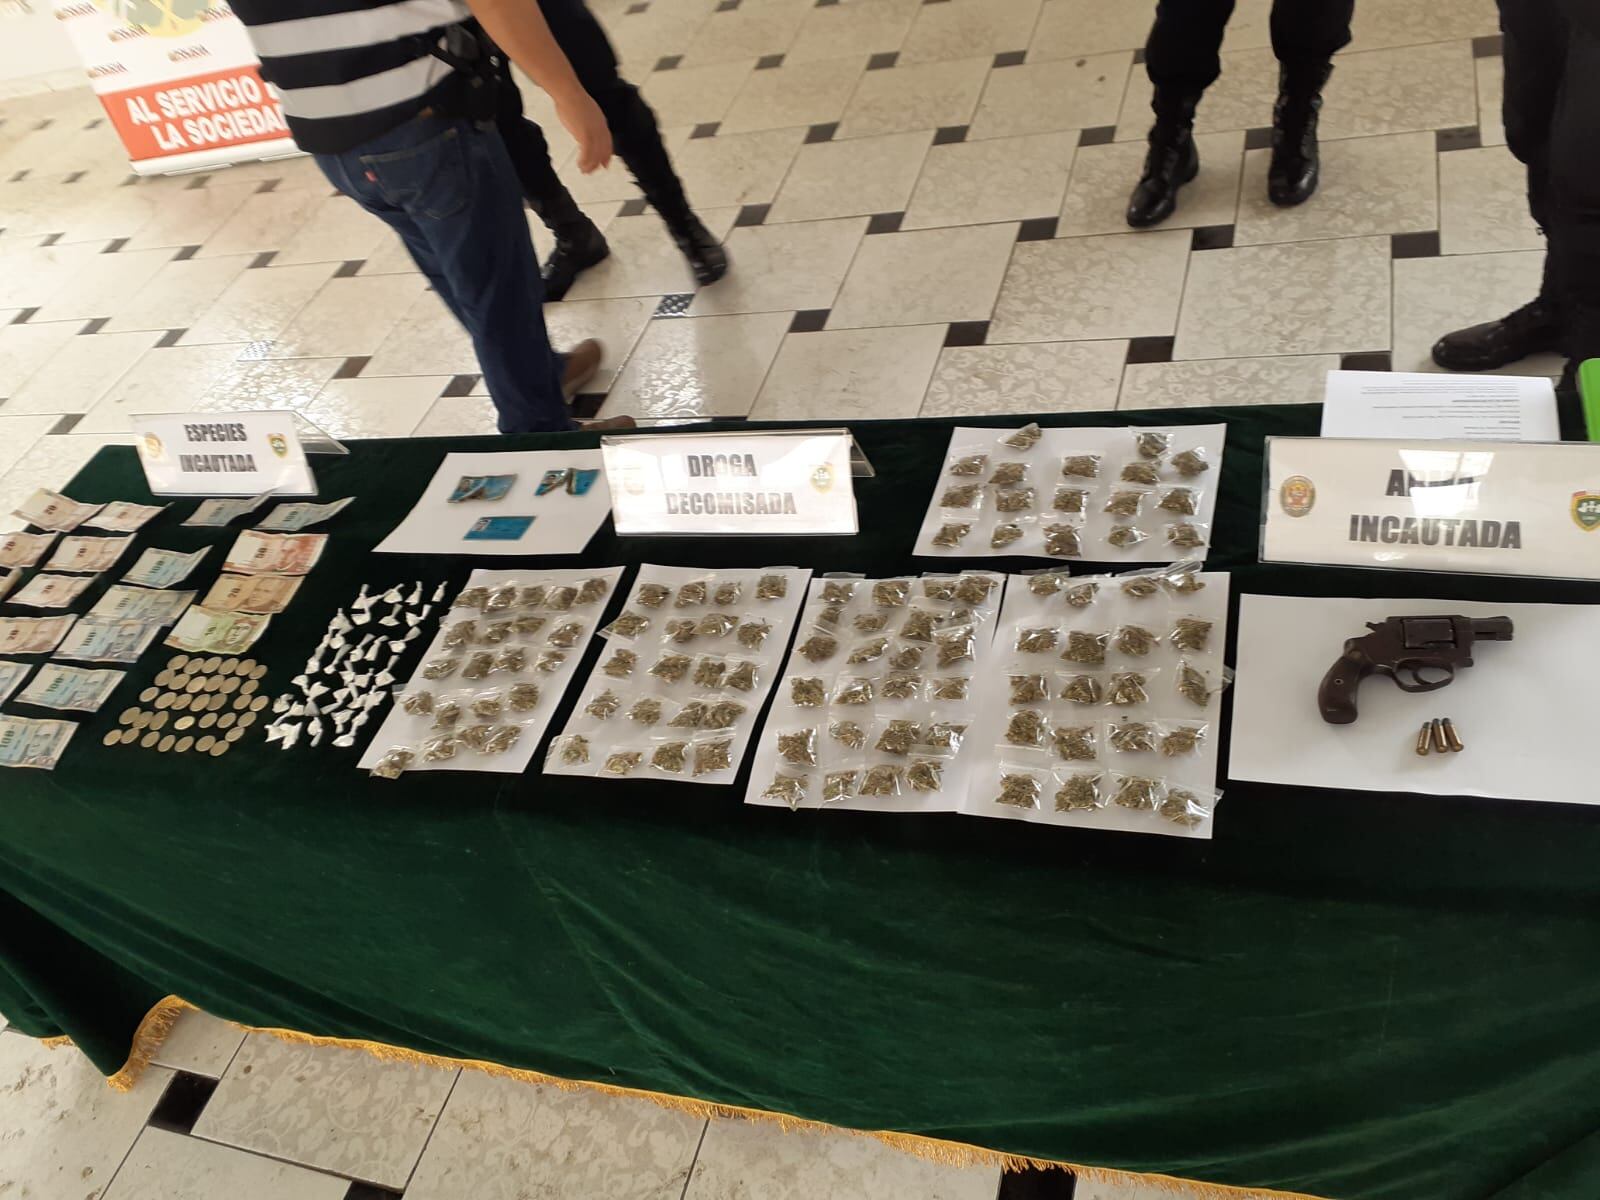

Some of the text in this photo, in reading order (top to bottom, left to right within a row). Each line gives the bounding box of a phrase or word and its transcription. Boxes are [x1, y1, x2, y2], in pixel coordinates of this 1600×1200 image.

[125, 96, 161, 126] AL
[156, 76, 260, 118] SERVICIO
[150, 121, 187, 151] LA
[184, 423, 248, 442] ESPECIES
[178, 454, 258, 473] INCAUTADA
[687, 454, 757, 478] DROGA
[665, 492, 797, 516] DECOMISADA
[1348, 514, 1522, 550] INCAUTADA
